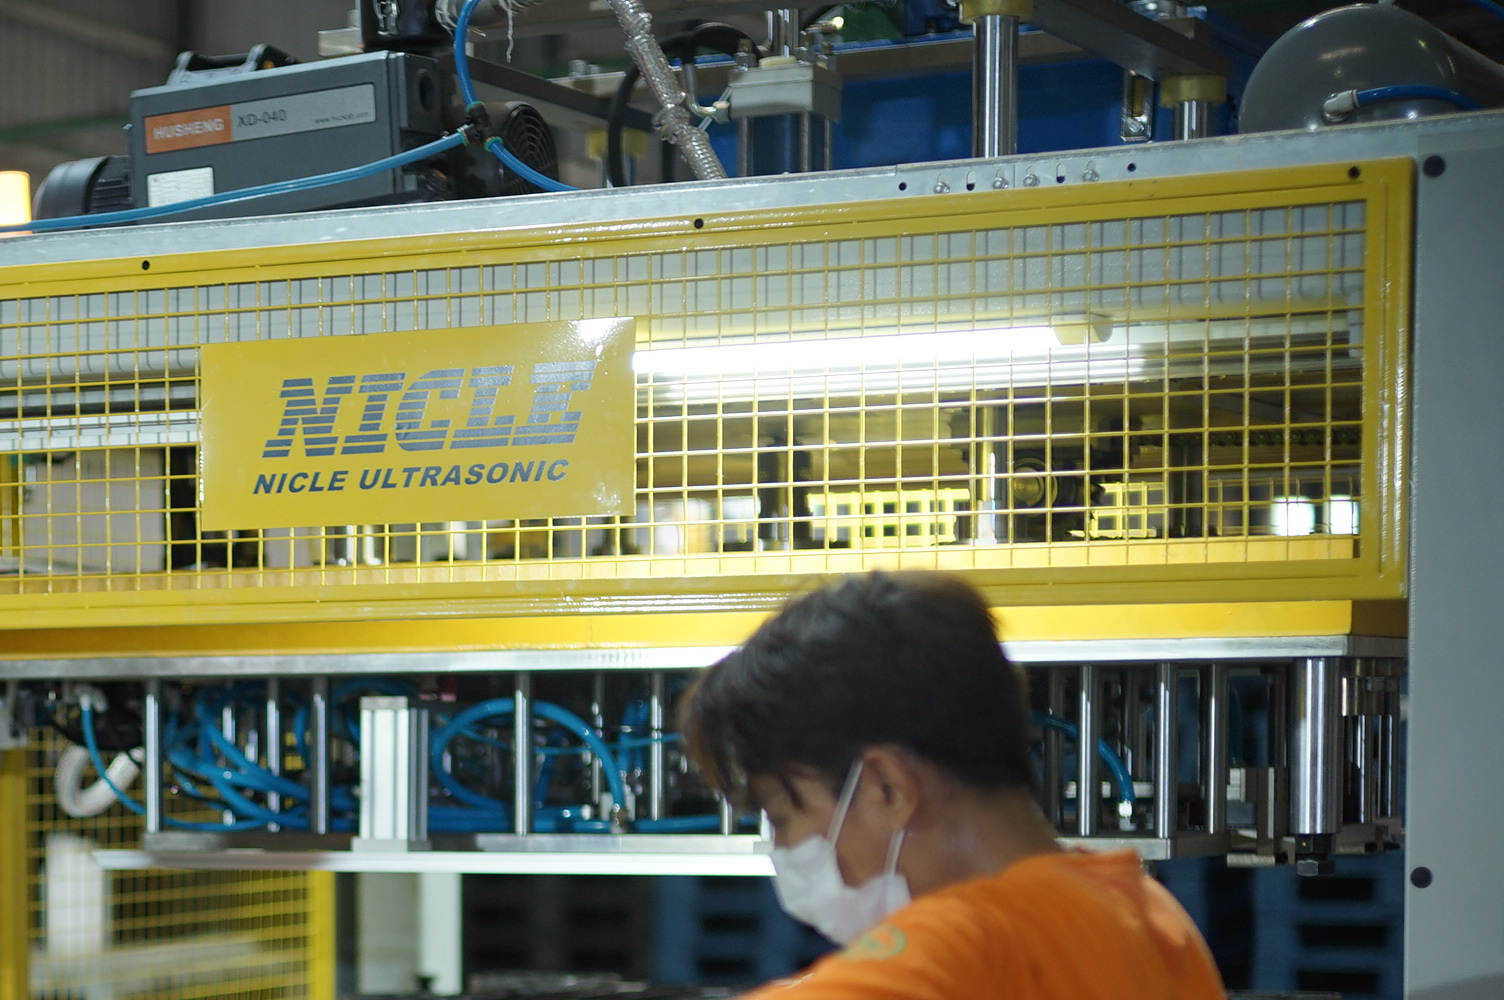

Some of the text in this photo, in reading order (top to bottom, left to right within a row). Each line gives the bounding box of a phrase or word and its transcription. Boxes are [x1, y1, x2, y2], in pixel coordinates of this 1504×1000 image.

[153, 118, 225, 140] HUSHENG
[262, 360, 596, 458] NICLE
[253, 459, 570, 495] NICLE ULTRASONIC
